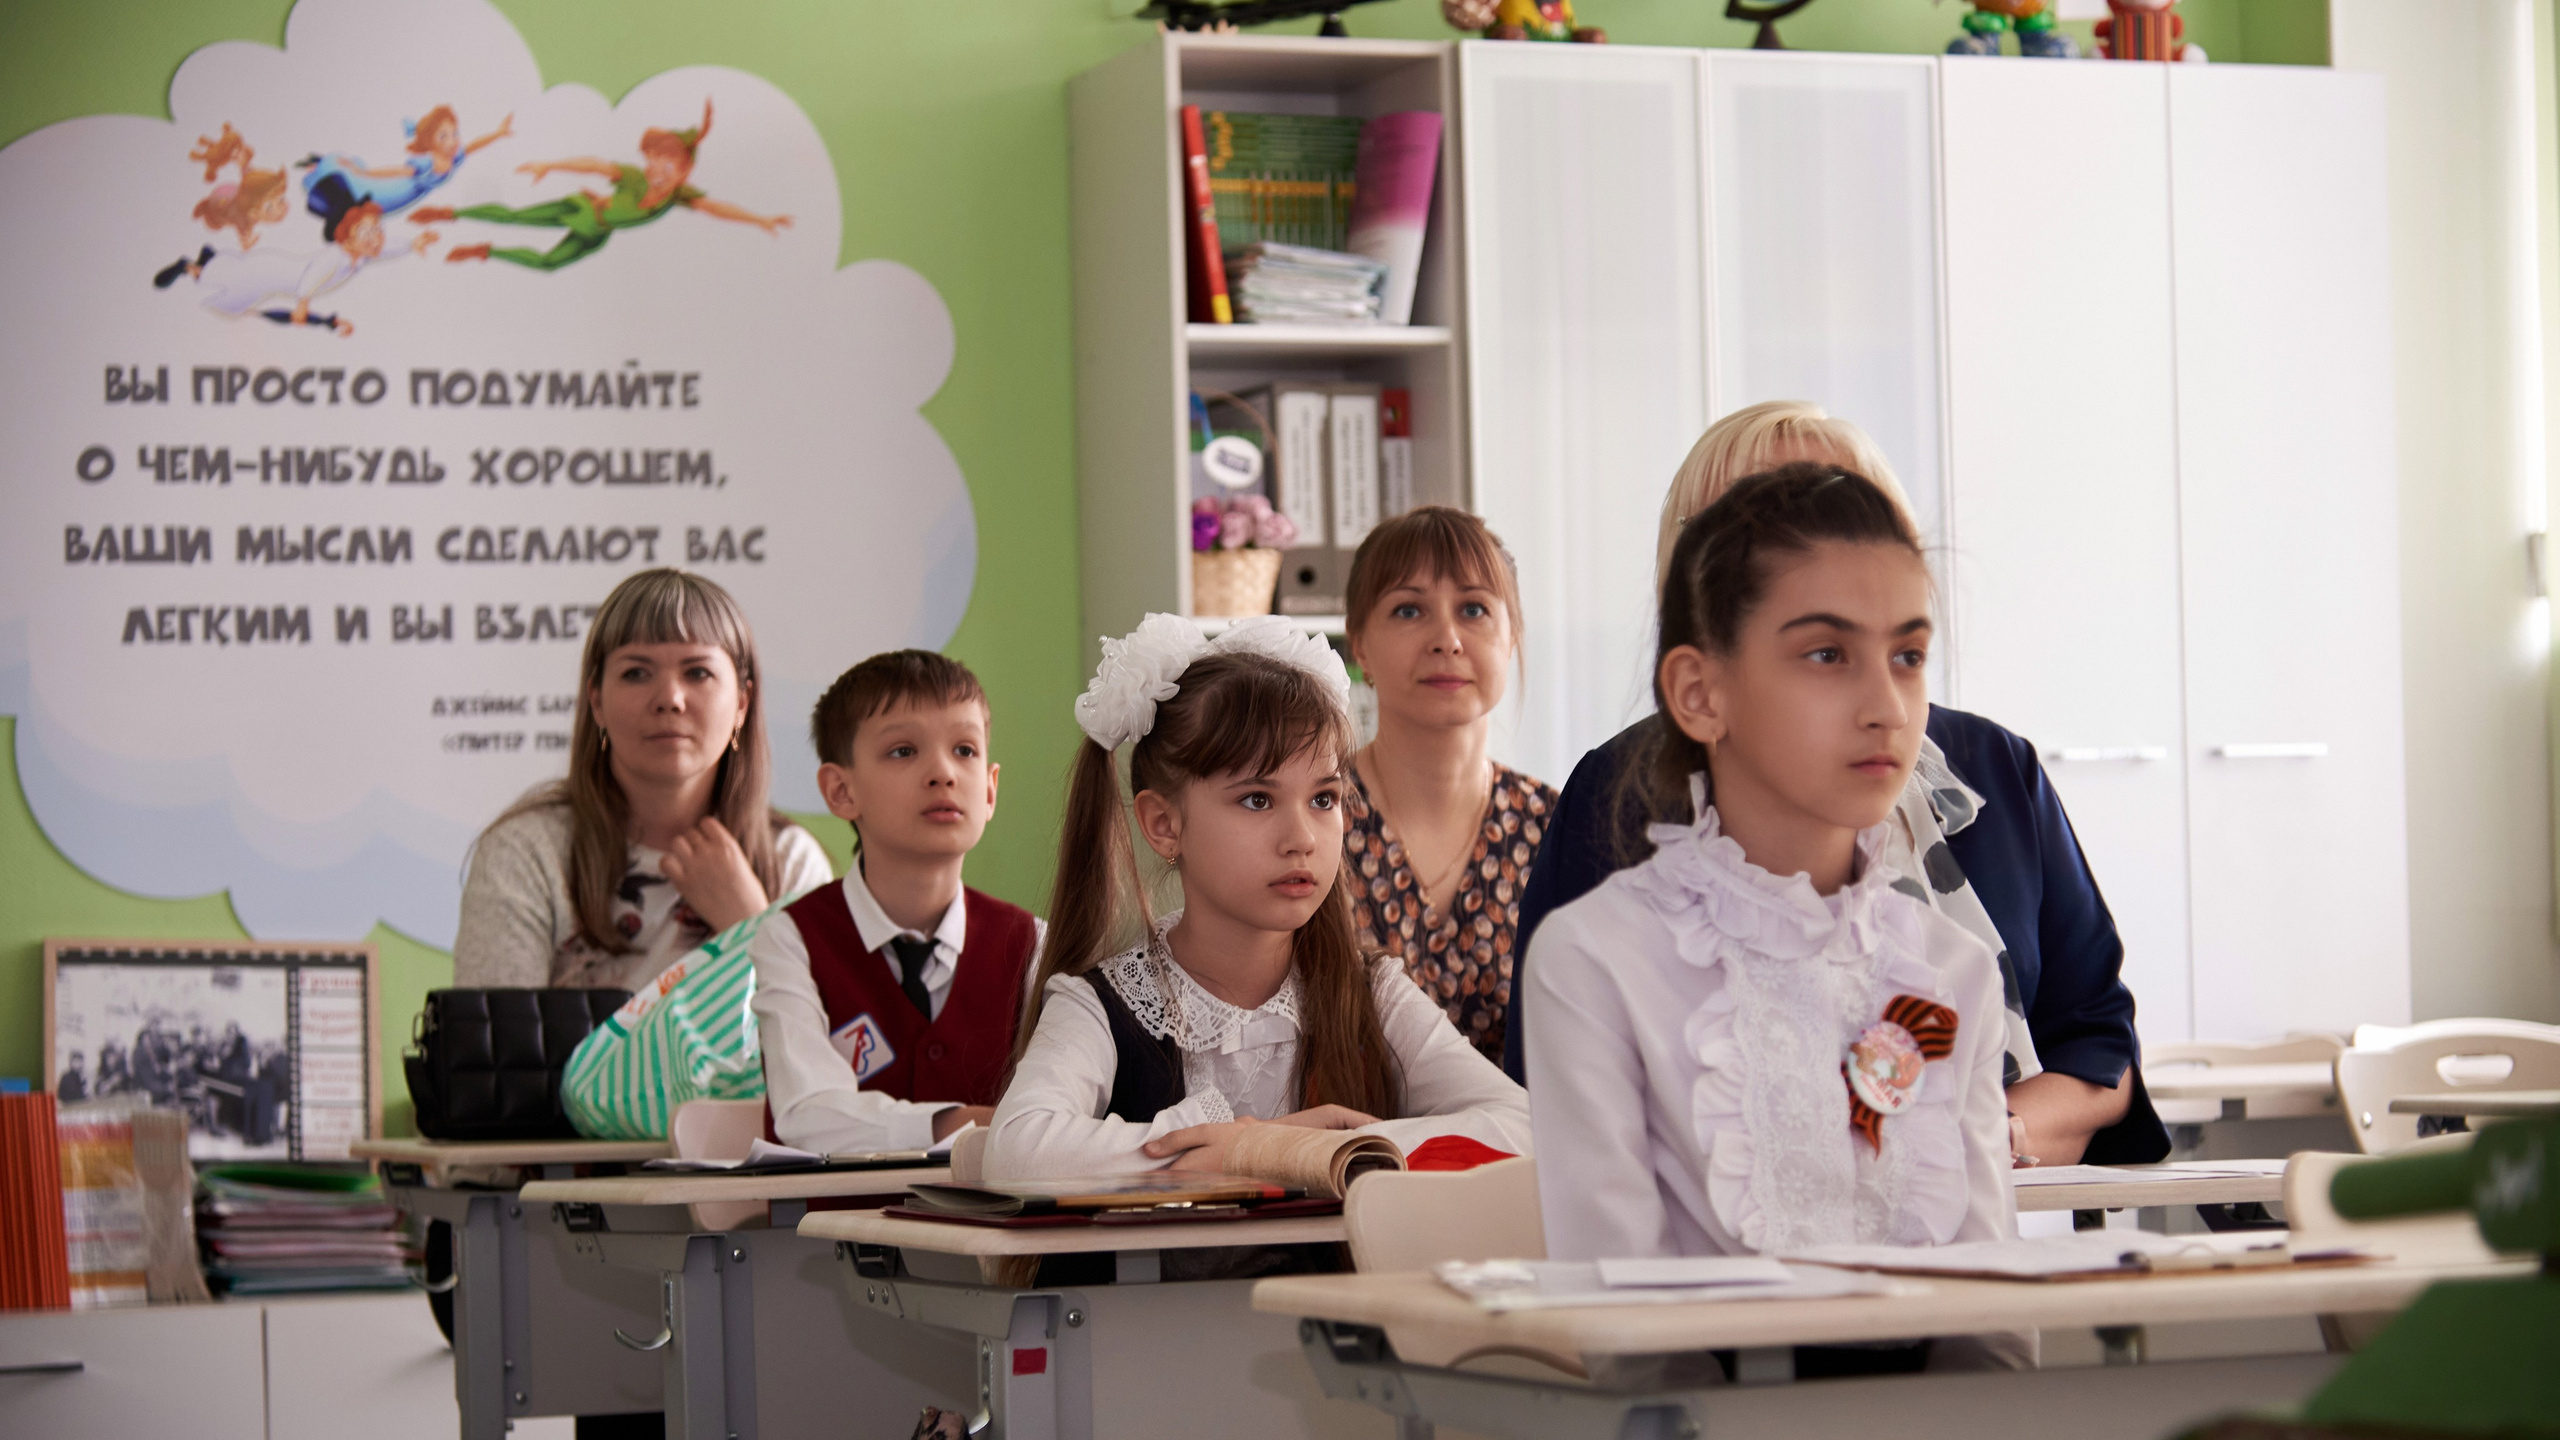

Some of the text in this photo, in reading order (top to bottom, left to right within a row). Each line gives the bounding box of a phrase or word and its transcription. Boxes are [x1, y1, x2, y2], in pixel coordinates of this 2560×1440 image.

[105, 359, 701, 410] ВЫ ПРОСТО ПОДУМАЙТЕ
[76, 444, 727, 488] О ЧЕМ-НИБУДЬ ХОРОШЕМ,
[64, 525, 767, 566] ВАШИ МЫСЛИ СДЕЛАЮТ ВАС
[121, 605, 312, 646] ЛЕГКИМ
[335, 605, 369, 645] И
[391, 604, 454, 643] ВЫ
